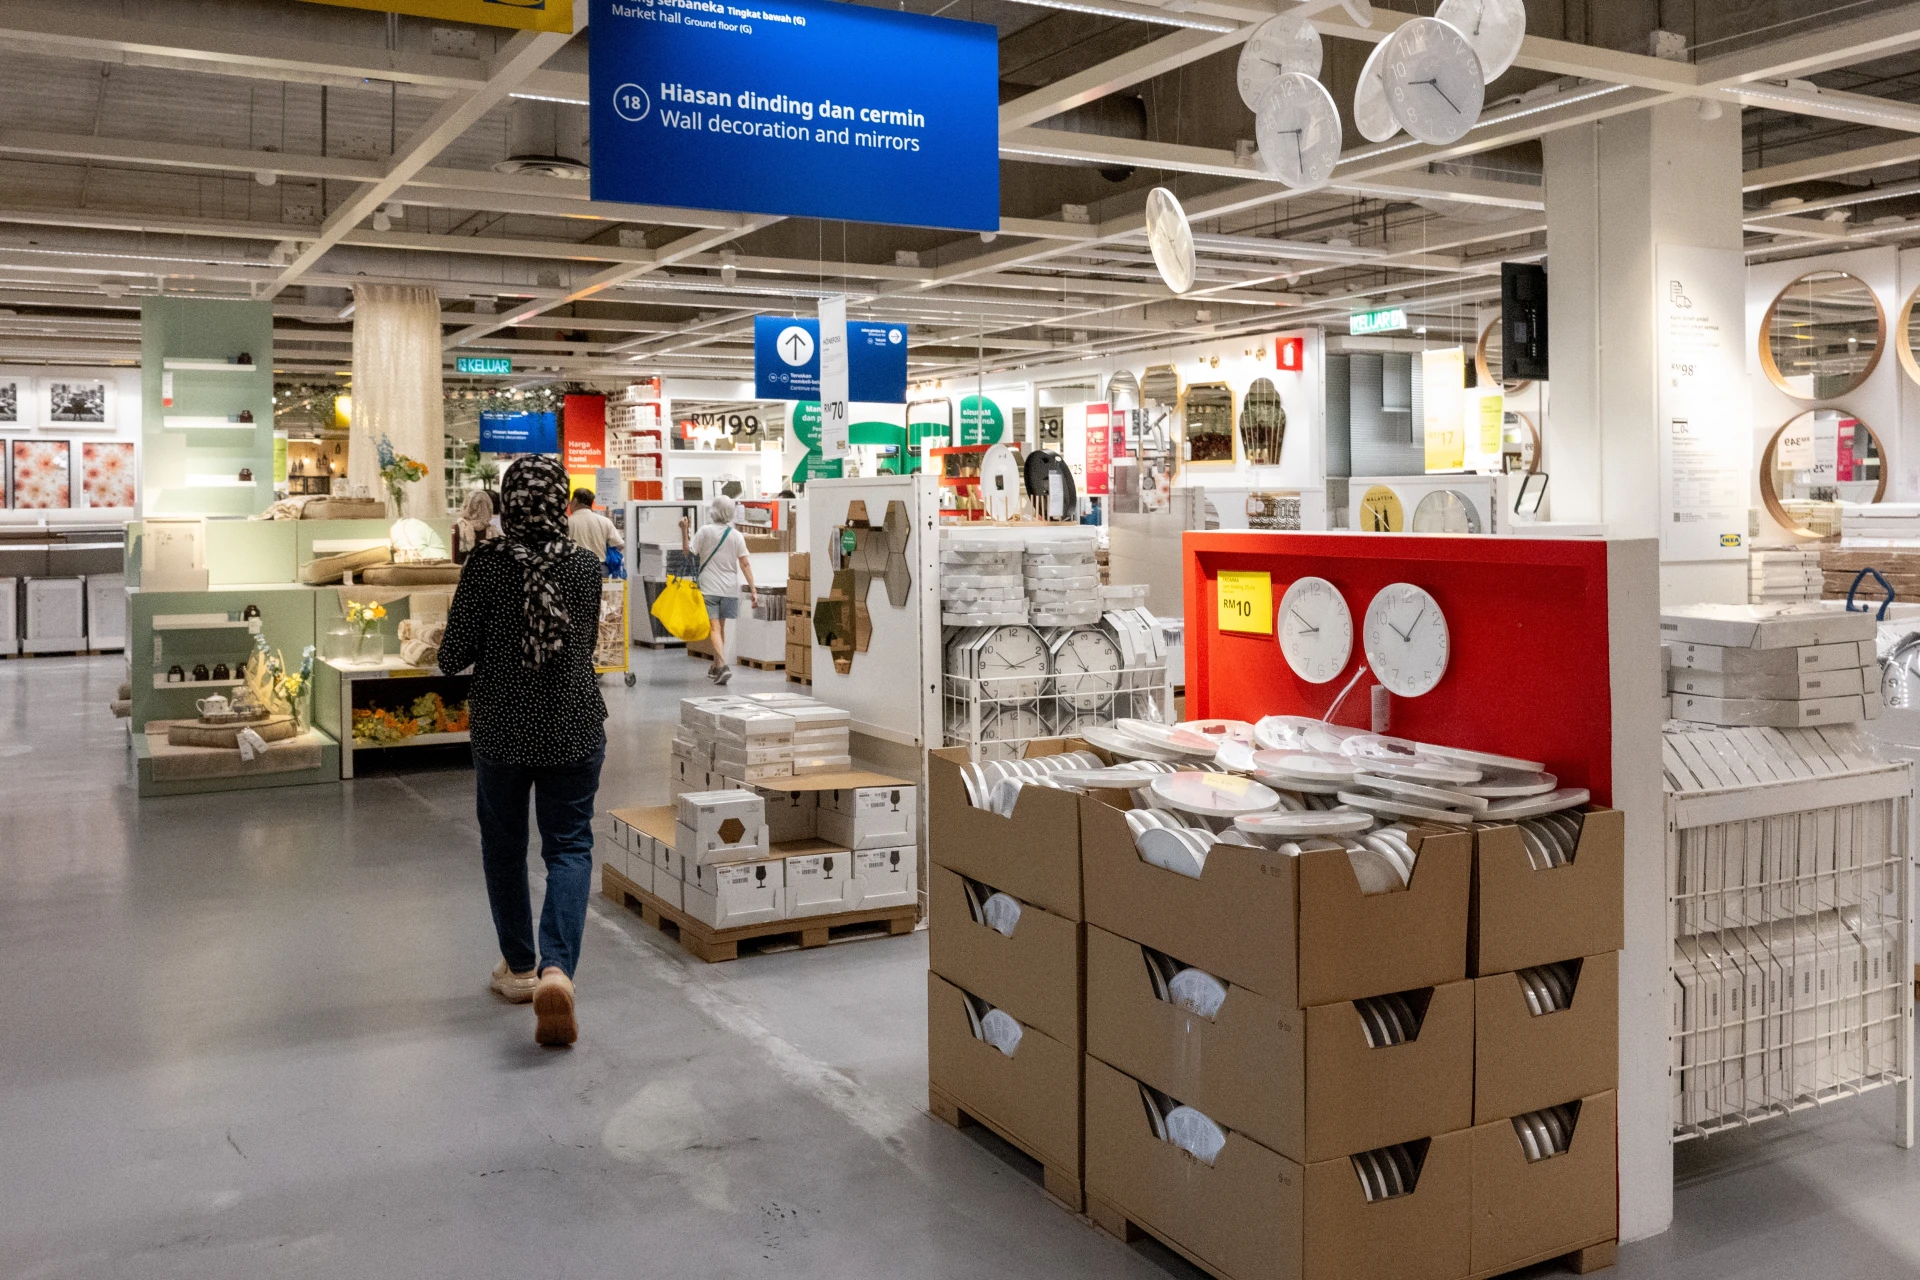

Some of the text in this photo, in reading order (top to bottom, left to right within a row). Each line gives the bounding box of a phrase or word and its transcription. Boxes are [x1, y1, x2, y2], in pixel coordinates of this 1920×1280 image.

[611, 4, 752, 35] Market hall Ground floor (G)
[658, 0, 724, 14] serbaneka
[727, 6, 761, 19] Tingkat
[762, 11, 792, 23] bawah
[793, 16, 806, 26] (G)
[1398, 39, 1412, 58] 11
[1391, 61, 1406, 80] 10
[1280, 80, 1295, 98] 12
[1395, 86, 1404, 102] 9
[622, 95, 641, 110] 18
[661, 82, 925, 127] Hiasan dinding dan cermin
[1270, 95, 1281, 111] 11
[1407, 107, 1418, 123] 8
[660, 109, 920, 152] Wall decoration and mirrors
[1352, 311, 1390, 333] KELUAR
[468, 359, 509, 373] KELUAR
[824, 401, 844, 420] RM70
[568, 440, 591, 449] Harga
[568, 455, 587, 463] kami
[1297, 589, 1306, 603] 11
[1309, 582, 1321, 596] 12
[1327, 587, 1332, 601] 1
[1337, 601, 1346, 616] 2
[1386, 593, 1396, 610] 11
[1421, 595, 1426, 610] 1
[1375, 610, 1388, 626] 10
[1432, 611, 1441, 626] 2
[1009, 628, 1018, 637] 12
[1286, 622, 1293, 636] 9
[1343, 622, 1350, 637] 3
[995, 634, 1002, 642] 11
[1027, 634, 1030, 643] 1
[1067, 639, 1075, 647] 2
[1372, 631, 1380, 645] 9
[1438, 633, 1446, 649] 3
[984, 645, 994, 654] 10
[1035, 646, 1042, 656] 2
[1291, 643, 1299, 656] 8
[979, 661, 986, 670] 9
[1038, 662, 1045, 671] 3
[1303, 657, 1310, 672] 7
[1331, 658, 1340, 672] 5
[1378, 652, 1387, 667] 8
[1435, 655, 1443, 669] 4
[1317, 664, 1325, 677] 6
[1391, 668, 1400, 683] 7
[1423, 670, 1433, 686] 5
[1407, 676, 1416, 691] 6
[1009, 711, 1018, 721] 12
[1028, 717, 1032, 726] 1
[985, 730, 995, 739] 10
[981, 746, 988, 755] 9
